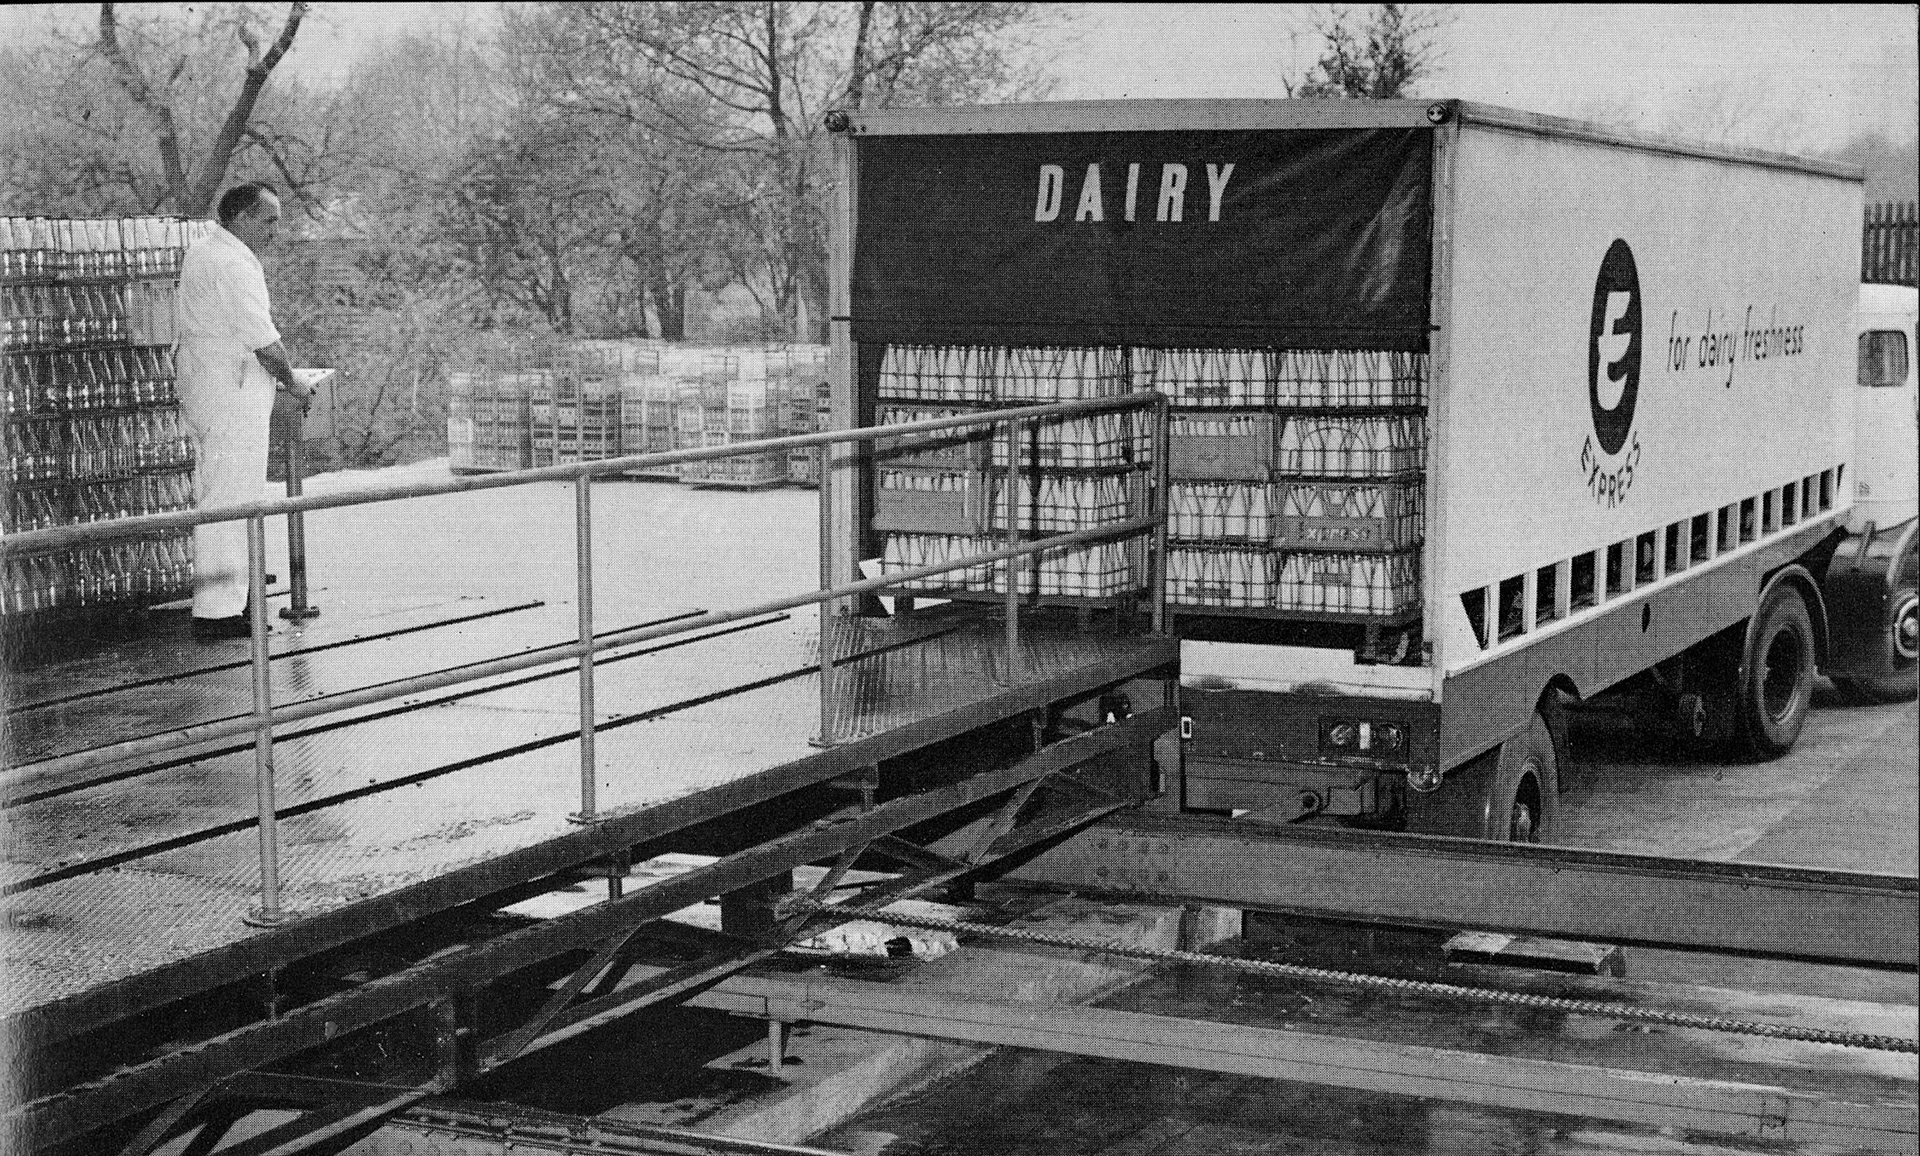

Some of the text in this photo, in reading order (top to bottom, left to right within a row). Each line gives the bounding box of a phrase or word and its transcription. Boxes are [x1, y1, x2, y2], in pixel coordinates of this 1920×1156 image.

[1034, 162, 1236, 222] DAIRY
[1667, 304, 1805, 389] for dairy freshness
[1581, 430, 1641, 509] EXPRESS
